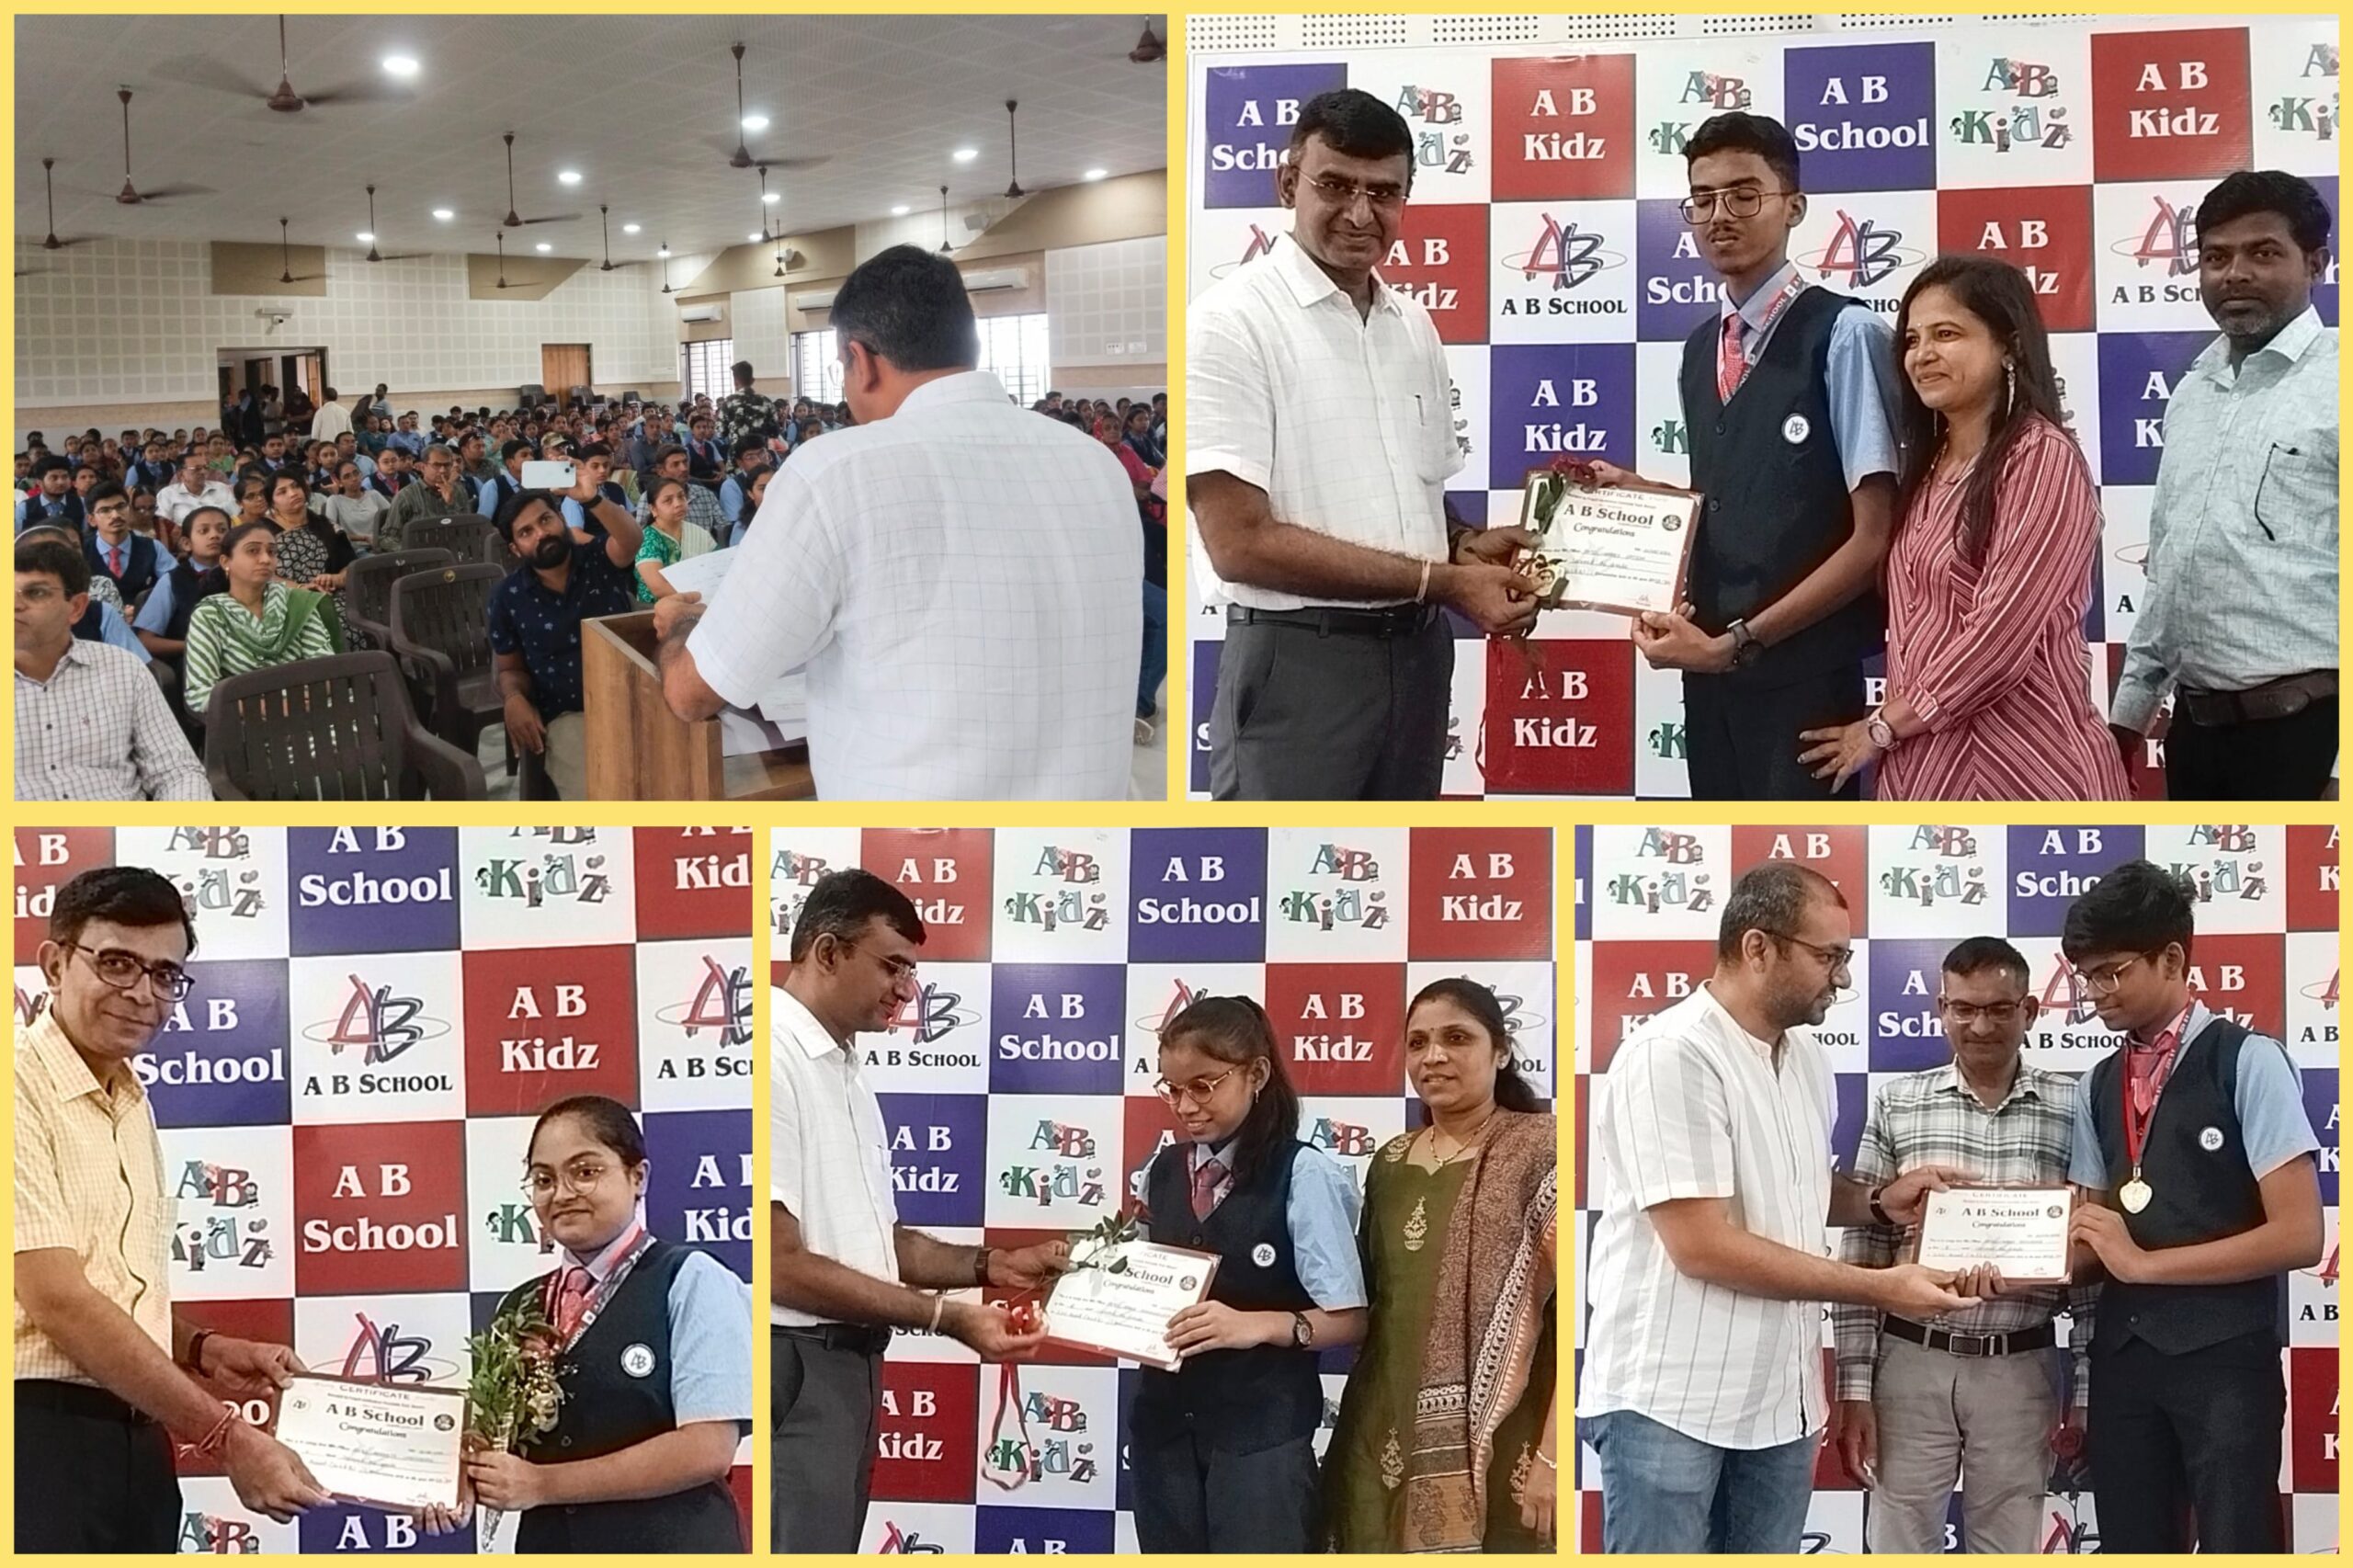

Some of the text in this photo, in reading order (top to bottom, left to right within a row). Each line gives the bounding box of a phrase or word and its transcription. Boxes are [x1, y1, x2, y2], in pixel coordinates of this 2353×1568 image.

[1820, 75, 1889, 105] A B
[2135, 62, 2209, 92] A B
[1236, 99, 1301, 127] A B
[1530, 87, 1597, 117] A B
[1795, 117, 1929, 152] School
[2130, 107, 2220, 138] Kidz
[1524, 131, 1606, 162] Kidz
[1672, 232, 1700, 258] A
[1977, 220, 2048, 249] A B
[1384, 239, 1449, 266] A B
[1501, 298, 1518, 315] A
[1526, 298, 1541, 315] B
[2112, 286, 2154, 303] A B
[1531, 379, 1598, 406] A B
[2141, 371, 2171, 399] A
[1524, 423, 1607, 452] Kidz
[1563, 505, 1654, 526] A B School
[2116, 596, 2134, 613] A
[1562, 671, 1588, 699] B
[1514, 717, 1597, 747] Kidz
[40, 835, 69, 865] B
[327, 825, 405, 853] A B
[1768, 833, 1831, 858] A B
[2040, 828, 2103, 854] A B
[675, 854, 753, 890] Kid
[896, 858, 958, 883] A B
[1162, 856, 1225, 882] A B
[1449, 853, 1515, 880] A B
[299, 867, 453, 907] School
[1137, 895, 1261, 924] School
[1441, 894, 1523, 922] Kidz
[1628, 972, 1690, 997] A B
[1902, 970, 1928, 995] A
[2187, 965, 2245, 992] A B
[207, 999, 238, 1030] B
[507, 984, 587, 1019] A B
[1023, 994, 1085, 1019] A B
[1300, 994, 1366, 1019] A B
[1878, 1011, 1949, 1038] Sch
[2301, 1026, 2338, 1042] A B
[999, 1035, 1120, 1061] School
[1293, 1035, 1373, 1062] Kidz
[2040, 1033, 2124, 1049] B SCHOO
[133, 1049, 285, 1085] School
[501, 1037, 599, 1073] Kidz
[657, 1059, 677, 1079] A
[688, 1058, 705, 1077] B
[865, 1051, 880, 1065] A
[888, 1051, 902, 1065] B
[1134, 1058, 1149, 1074] A
[302, 1076, 323, 1096] A
[332, 1075, 351, 1095] B
[891, 1125, 952, 1151] A B
[332, 1164, 412, 1198] A B
[690, 1154, 726, 1187] A
[684, 1207, 753, 1242] Kid
[1961, 1208, 2040, 1217] A B School
[303, 1214, 460, 1253] School
[1124, 1267, 1173, 1285] School
[2299, 1304, 2339, 1321] A B
[326, 1403, 424, 1426] A B School
[881, 1391, 936, 1416] A B
[335, 1515, 417, 1550] A B
